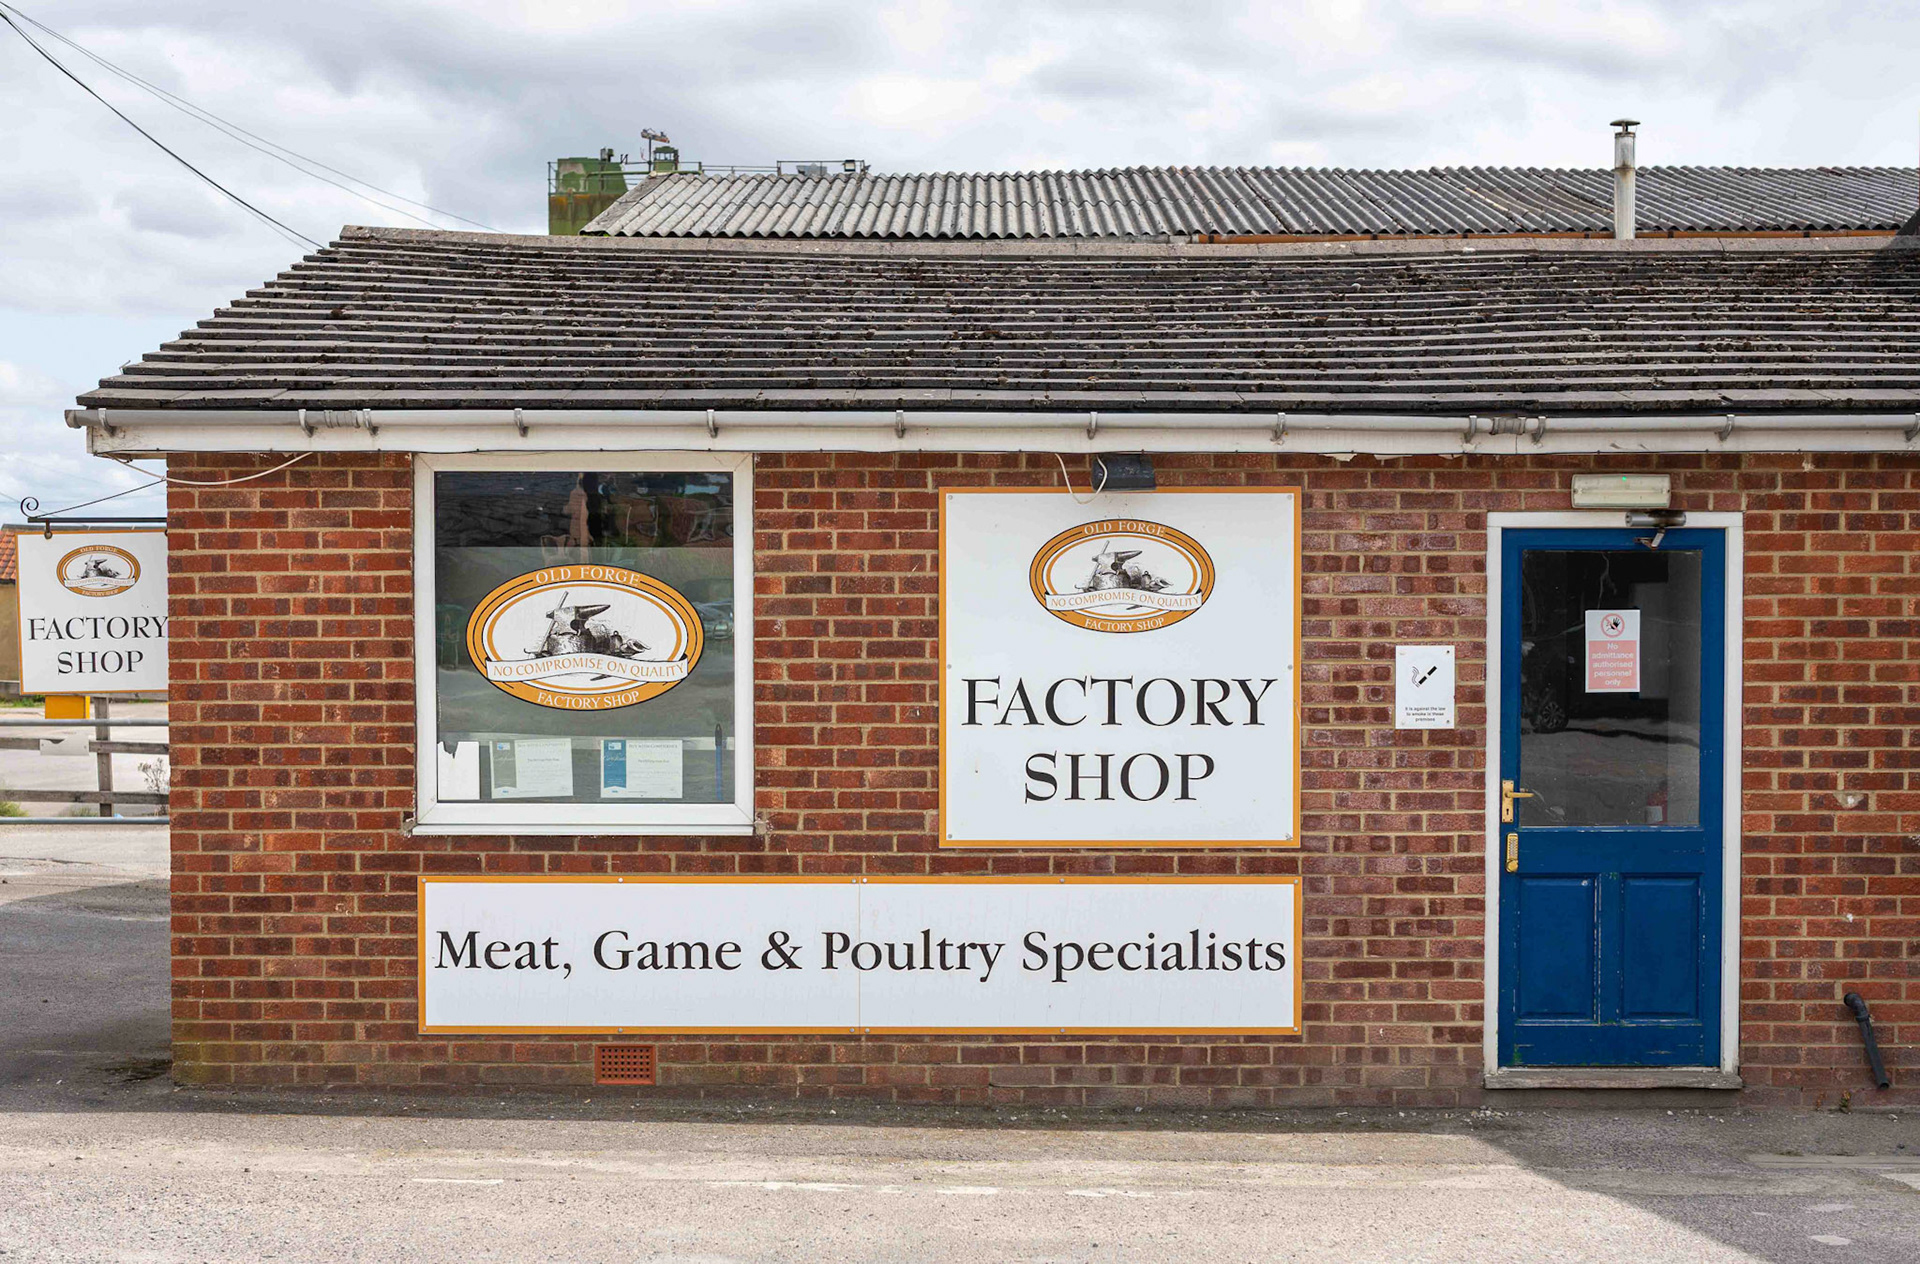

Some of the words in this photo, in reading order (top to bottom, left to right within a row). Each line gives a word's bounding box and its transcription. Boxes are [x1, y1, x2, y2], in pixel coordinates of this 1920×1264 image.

[1084, 522, 1112, 535] OLD
[1118, 521, 1166, 537] FORGE
[536, 568, 572, 585] OLD
[580, 566, 641, 586] FORGE
[1051, 597, 1067, 607] NO
[1068, 591, 1136, 606] COMPROMISE
[1139, 593, 1155, 605] ON
[1157, 595, 1200, 608] QUALITY
[27, 616, 168, 641] FACTORY
[1085, 618, 1135, 632] FACTORY
[1136, 617, 1165, 631] SHOP
[57, 650, 144, 675] SHOP
[493, 665, 513, 677] NO
[515, 659, 603, 676] COMPROMISE
[607, 660, 627, 674] ON
[630, 662, 686, 678] QUALITY
[1594, 670, 1632, 678] personnel
[537, 691, 601, 709] FACTORY
[603, 690, 640, 707] SHOP
[961, 675, 1279, 727] FACTORY
[1025, 751, 1215, 804] SHOP
[434, 930, 572, 979] Meat,
[593, 930, 742, 971] Game
[761, 930, 803, 971] &
[821, 928, 1006, 983] Poultry
[1022, 928, 1287, 983] Specialists
